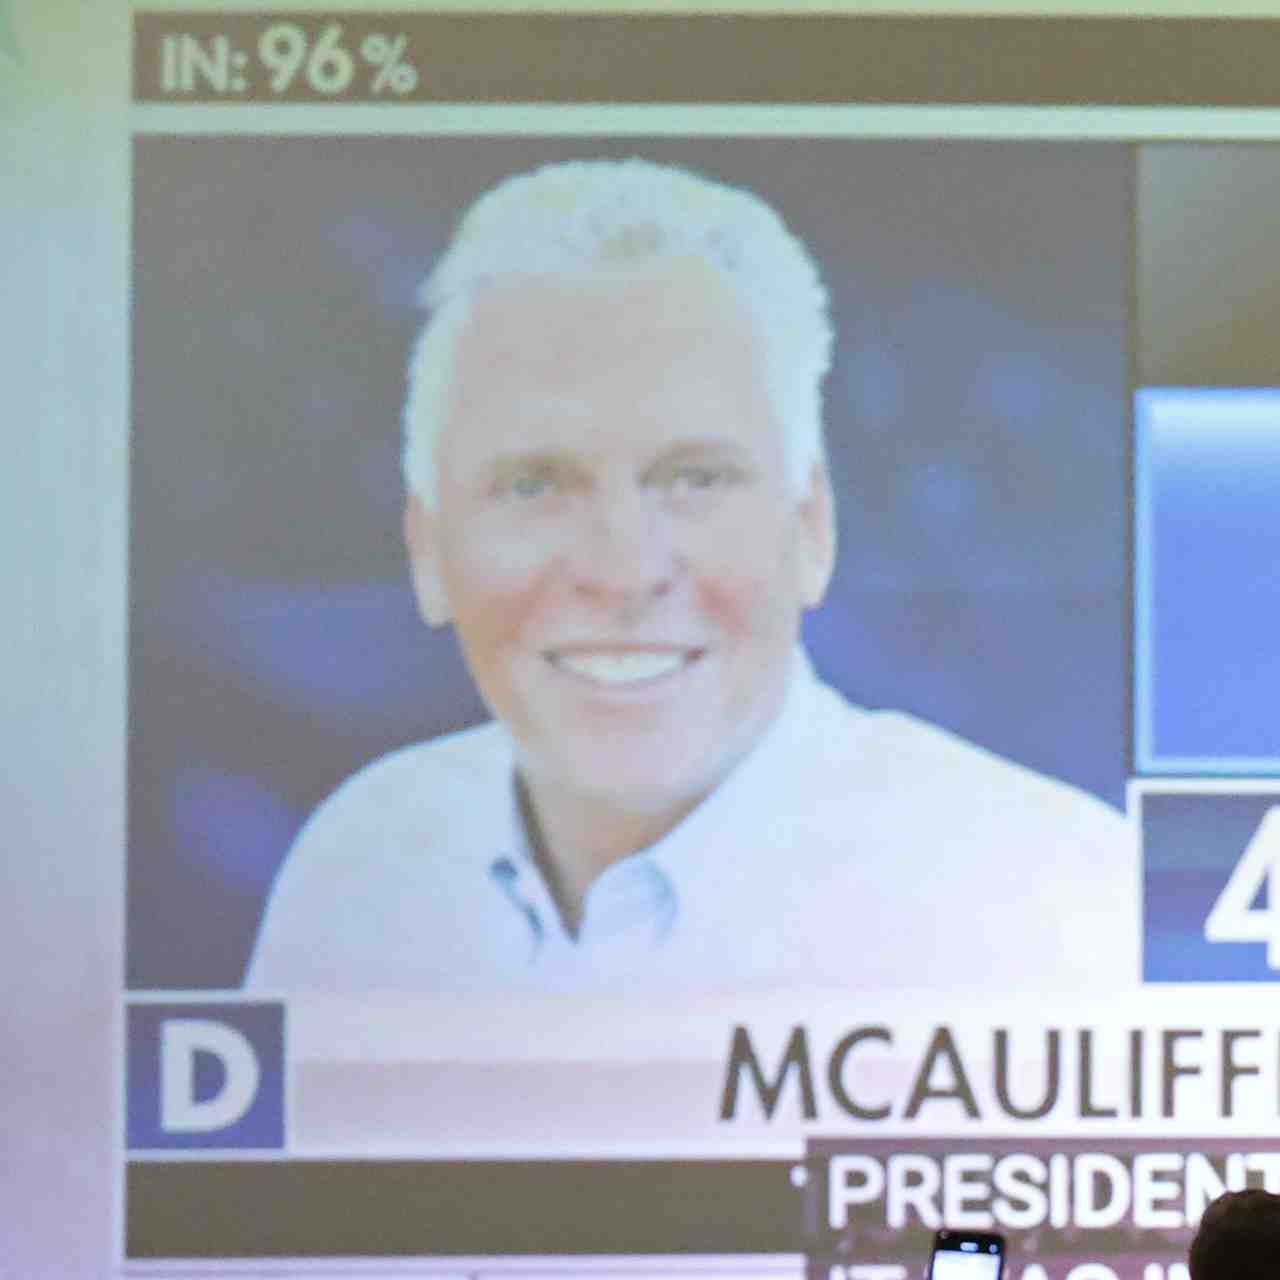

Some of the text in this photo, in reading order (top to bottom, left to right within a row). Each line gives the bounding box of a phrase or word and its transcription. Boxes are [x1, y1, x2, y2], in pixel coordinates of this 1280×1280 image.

[160, 24, 419, 95] IN: 96%
[159, 1020, 260, 1134] D
